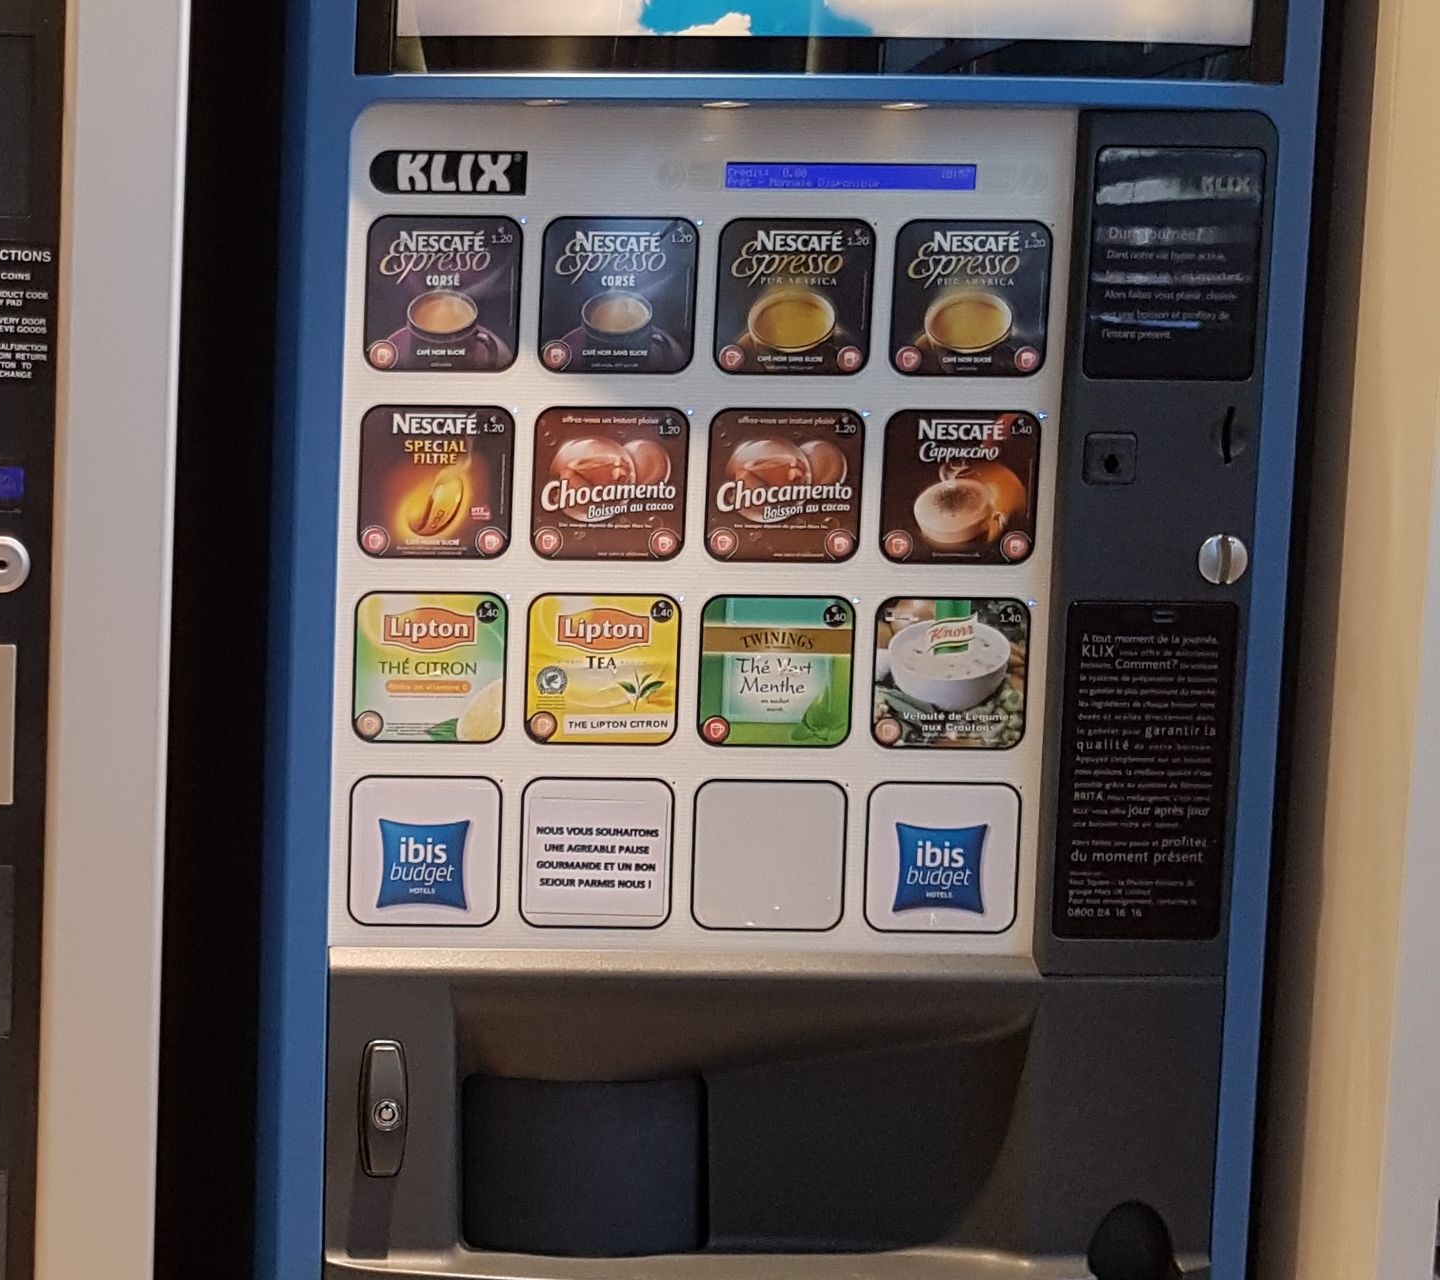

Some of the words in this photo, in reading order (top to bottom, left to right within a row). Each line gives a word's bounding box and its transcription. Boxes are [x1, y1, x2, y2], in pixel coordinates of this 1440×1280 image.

[396, 152, 513, 193] KLIX
[399, 230, 485, 251] NESCAFÉ
[491, 234, 513, 243] 1.20
[575, 231, 661, 252] NESCAFÉ
[671, 234, 693, 243] 1.20
[756, 230, 843, 251] NESCAFÉ
[933, 230, 1020, 252] NESCAFÉ
[379, 239, 491, 285] Espresso
[555, 238, 667, 285] Espresso
[731, 240, 844, 287] Espresso
[907, 241, 1020, 289] Espresso
[0, 272, 31, 280] COINS
[5, 299, 23, 307] PAD
[25, 291, 49, 300] CODE
[392, 412, 478, 435] NESCAFÉ
[483, 423, 505, 433] 1.20
[659, 426, 681, 435] 1.20
[835, 424, 857, 434] 1.20
[917, 419, 1005, 440] NESCAFÉ
[404, 440, 467, 453] SPECIAL
[919, 440, 999, 463] Cappuccino
[413, 453, 457, 465] FILTRE
[540, 479, 677, 512] Chocamento
[716, 480, 853, 512] Chocamento
[587, 504, 628, 519] Boisson
[629, 504, 643, 512] au
[645, 503, 674, 511] cacao
[762, 504, 803, 520] Boisson
[805, 504, 819, 513] au
[821, 503, 850, 512] cacao
[478, 609, 499, 618] 1.40
[824, 612, 846, 623] 1.40
[1000, 613, 1022, 624] 1.40
[390, 617, 469, 643] Lipton
[564, 617, 644, 644] Lipton
[740, 628, 816, 651] TWININGS
[1081, 644, 1115, 658] KLIX
[378, 657, 410, 675] THÉ
[414, 661, 477, 675] CITRON
[586, 656, 617, 670] TEA
[736, 657, 770, 675] Thé
[1115, 658, 1178, 670] Comment?
[739, 676, 806, 695] Menthe
[568, 721, 587, 729] THE
[590, 721, 627, 729] LIPTON
[629, 721, 668, 729] CITRON
[1145, 725, 1200, 738] garantir
[1076, 739, 1130, 753] qualité
[536, 826, 565, 836] NOUS
[567, 827, 594, 837] VOUS
[595, 827, 659, 838] SOUHAITONS
[399, 837, 447, 864] ibis
[544, 843, 565, 853] UNE
[567, 844, 616, 854] AGREABLE
[618, 845, 650, 855] PAUSE
[916, 840, 965, 868] ibis
[1070, 849, 1088, 863] du
[1092, 850, 1149, 863] moment
[1153, 851, 1204, 866] présent
[390, 862, 455, 886] budget
[536, 860, 601, 871] GOURMANDE
[603, 862, 615, 871] ET
[617, 862, 633, 871] UN
[634, 862, 656, 872] BON
[539, 878, 576, 888] SEJOUR
[577, 879, 616, 889] PARMIS
[617, 879, 645, 889] NOUS
[906, 866, 973, 889] budget
